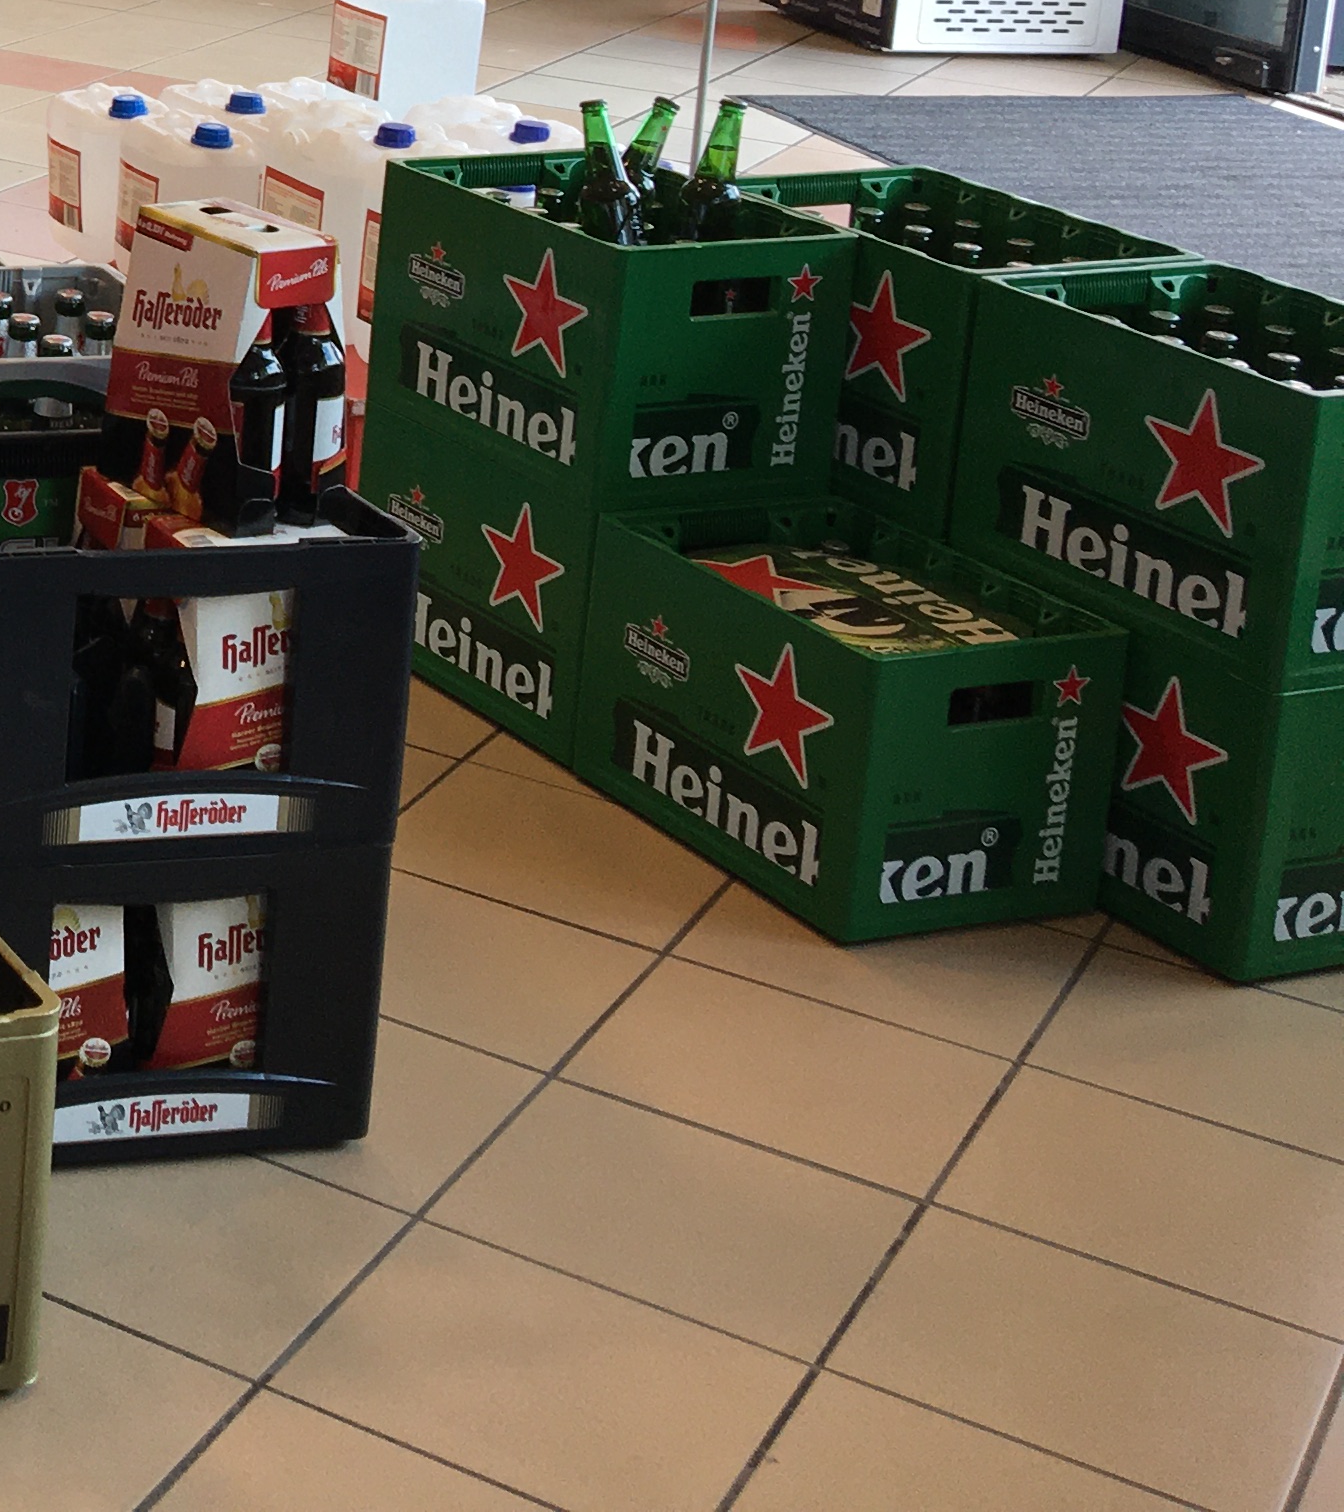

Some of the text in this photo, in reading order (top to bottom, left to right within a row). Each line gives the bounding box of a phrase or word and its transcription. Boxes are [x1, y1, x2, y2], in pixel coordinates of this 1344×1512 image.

[267, 271, 312, 292] Premium
[411, 257, 463, 294] Heineken
[132, 288, 222, 331] Hasseröder
[136, 360, 182, 385] Premium
[769, 310, 811, 467] Heineken
[1013, 390, 1087, 434] Heineken
[390, 496, 443, 541] Heineken
[626, 626, 689, 679] Heineken
[155, 798, 247, 834] Hasseröder
[1032, 714, 1079, 885] Heineken
[128, 1093, 219, 1133] Hasseröder
